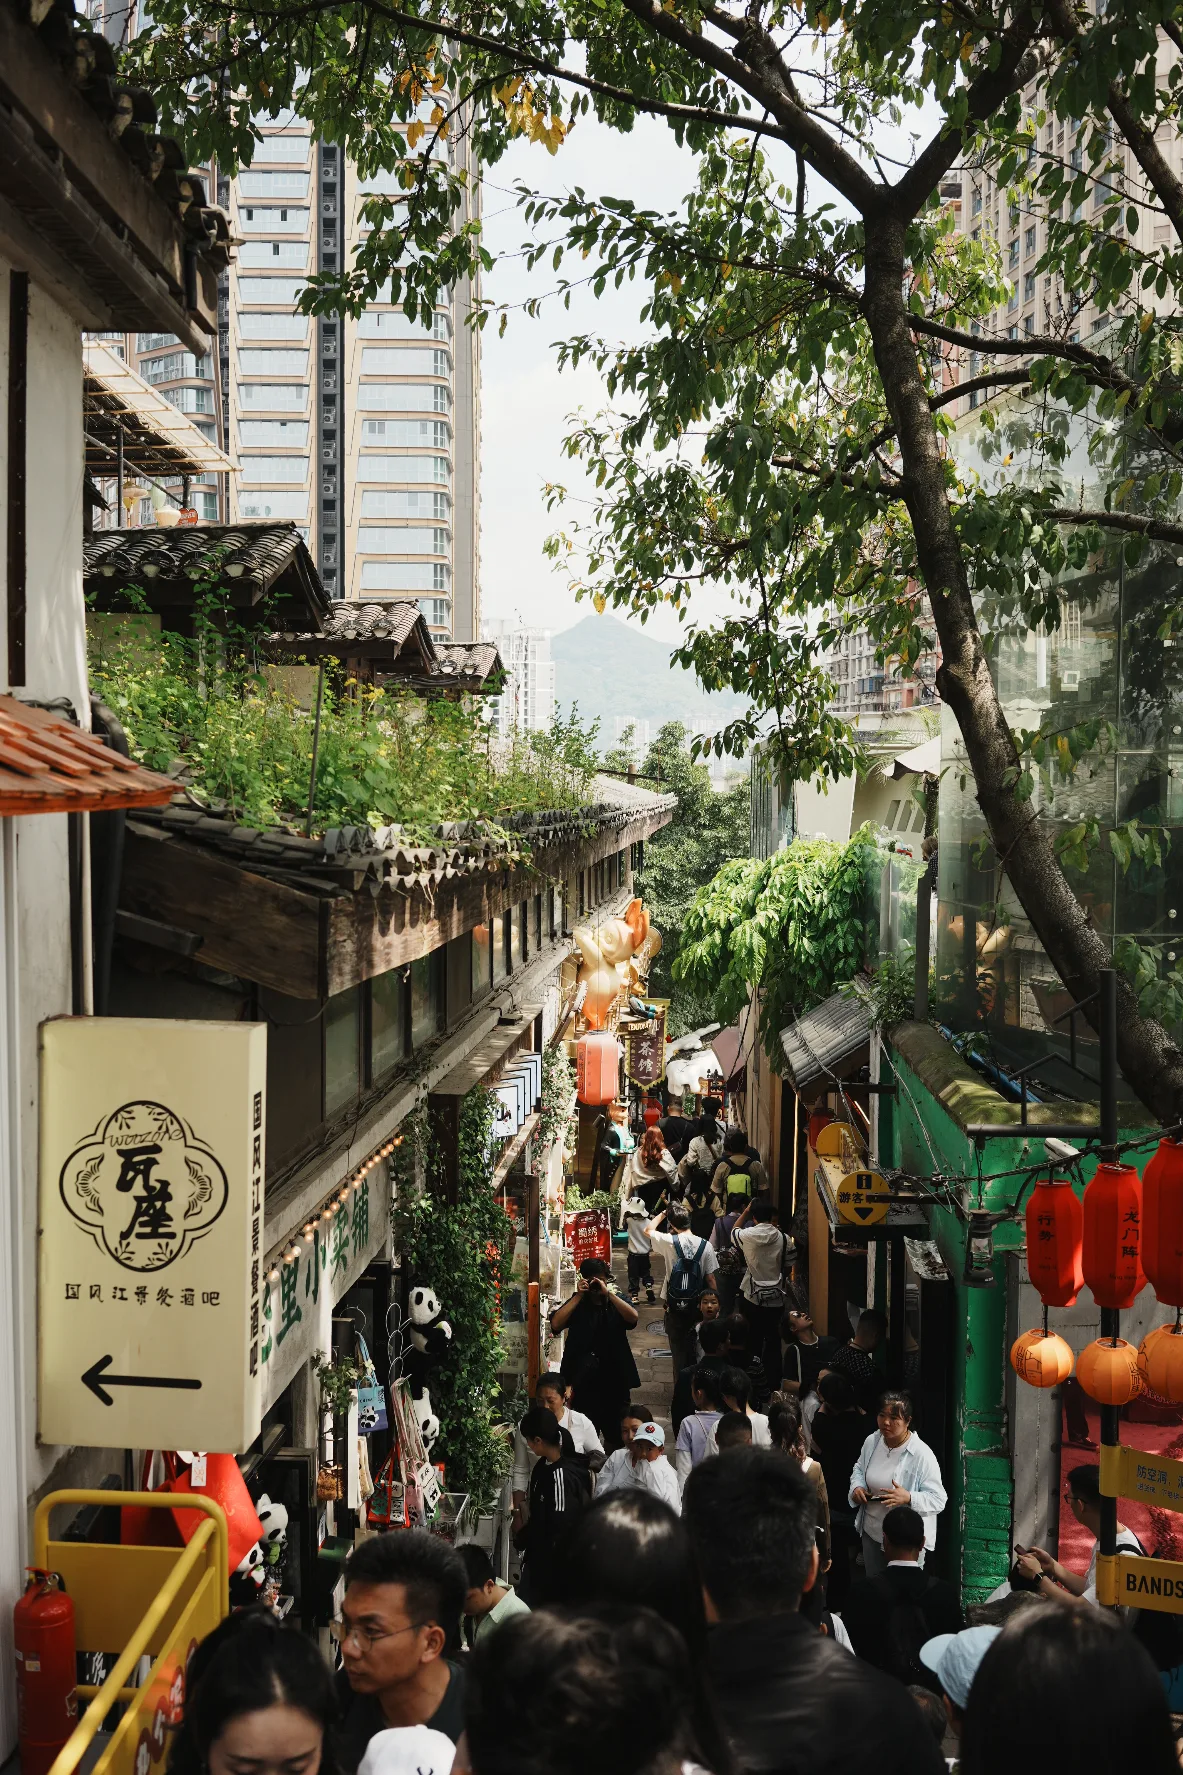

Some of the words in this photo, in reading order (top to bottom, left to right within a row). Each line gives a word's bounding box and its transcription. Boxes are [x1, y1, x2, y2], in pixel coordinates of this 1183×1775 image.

[638, 1041, 655, 1073] 茶馆
[1038, 1215, 1054, 1241] 行势
[1122, 1211, 1140, 1258] 龙门阵
